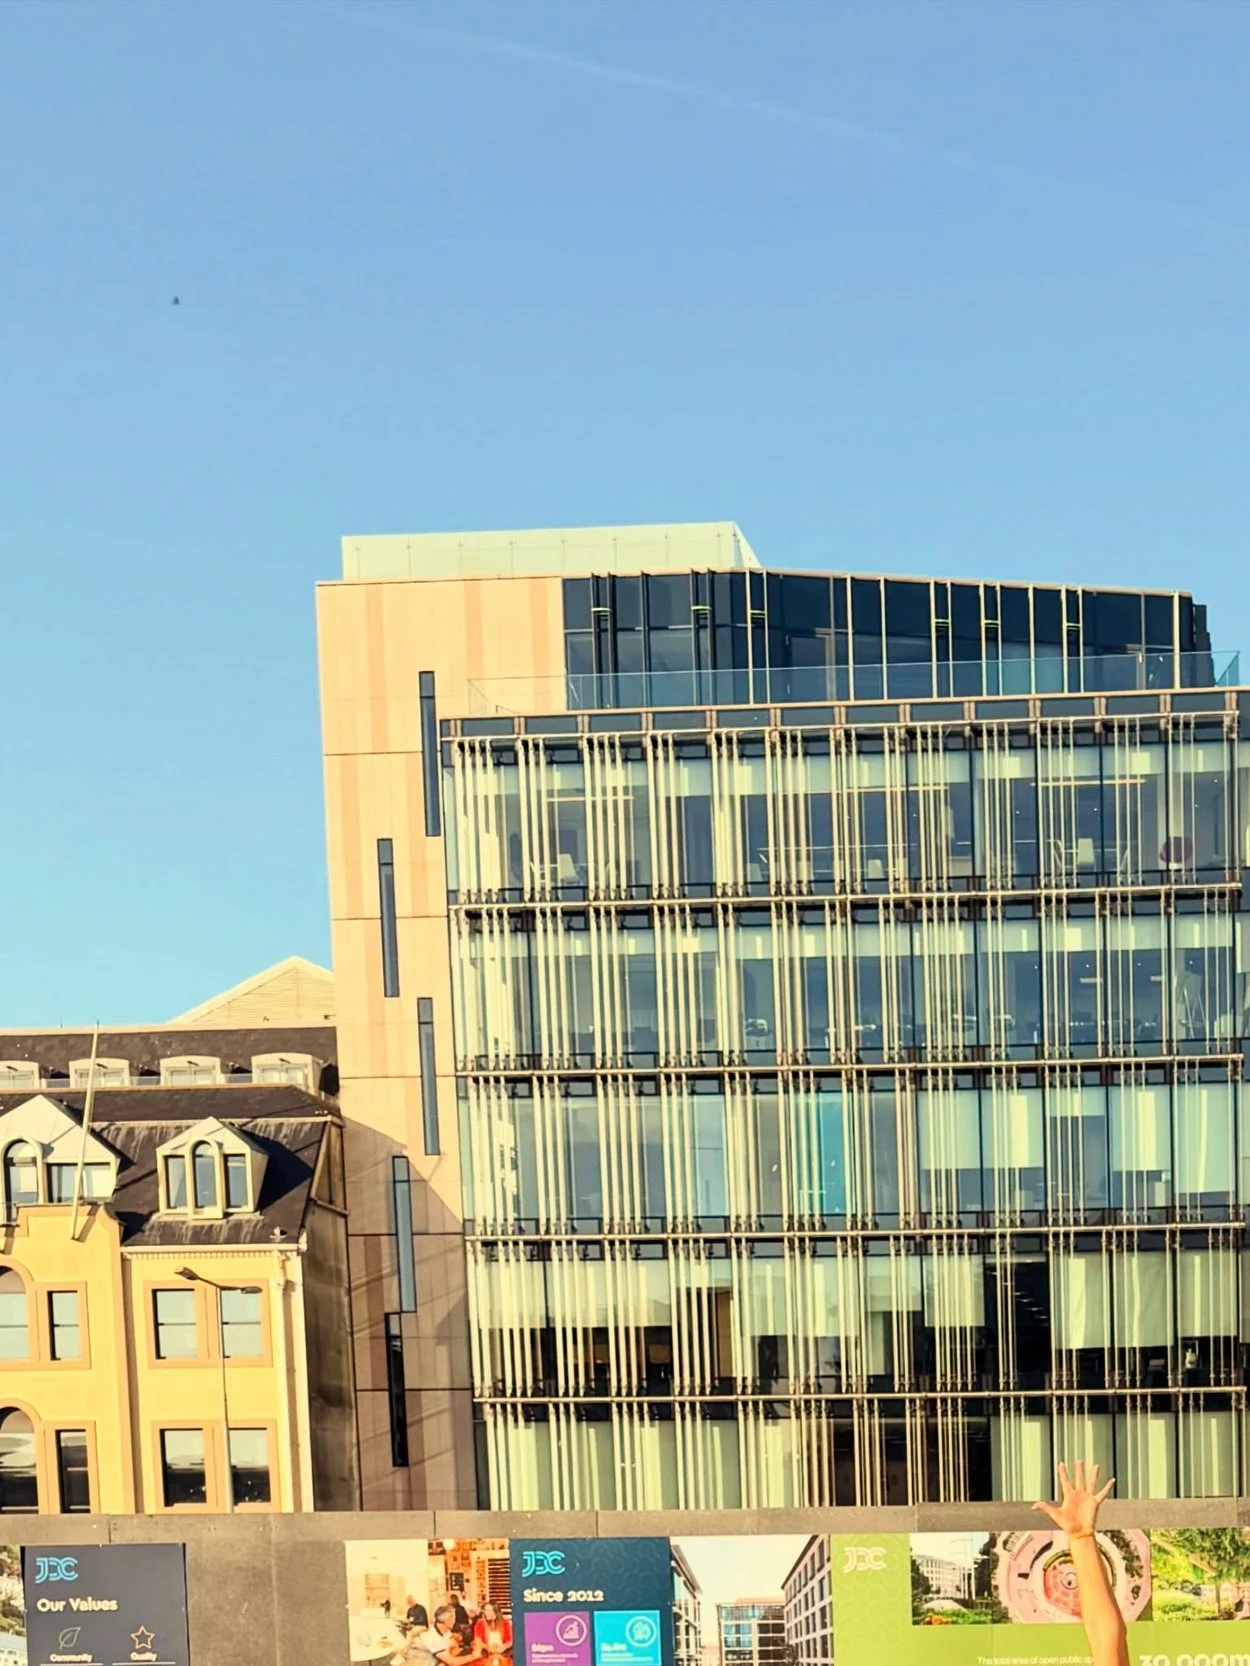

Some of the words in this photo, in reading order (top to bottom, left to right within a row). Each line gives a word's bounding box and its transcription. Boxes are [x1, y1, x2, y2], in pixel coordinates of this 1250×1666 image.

[35, 1557, 78, 1584] JDC
[521, 1551, 565, 1578] JDC
[843, 1546, 888, 1574] JDC
[37, 1598, 66, 1612] Our
[69, 1596, 118, 1611] Values
[523, 1588, 563, 1603] Since
[567, 1590, 605, 1602] 2012
